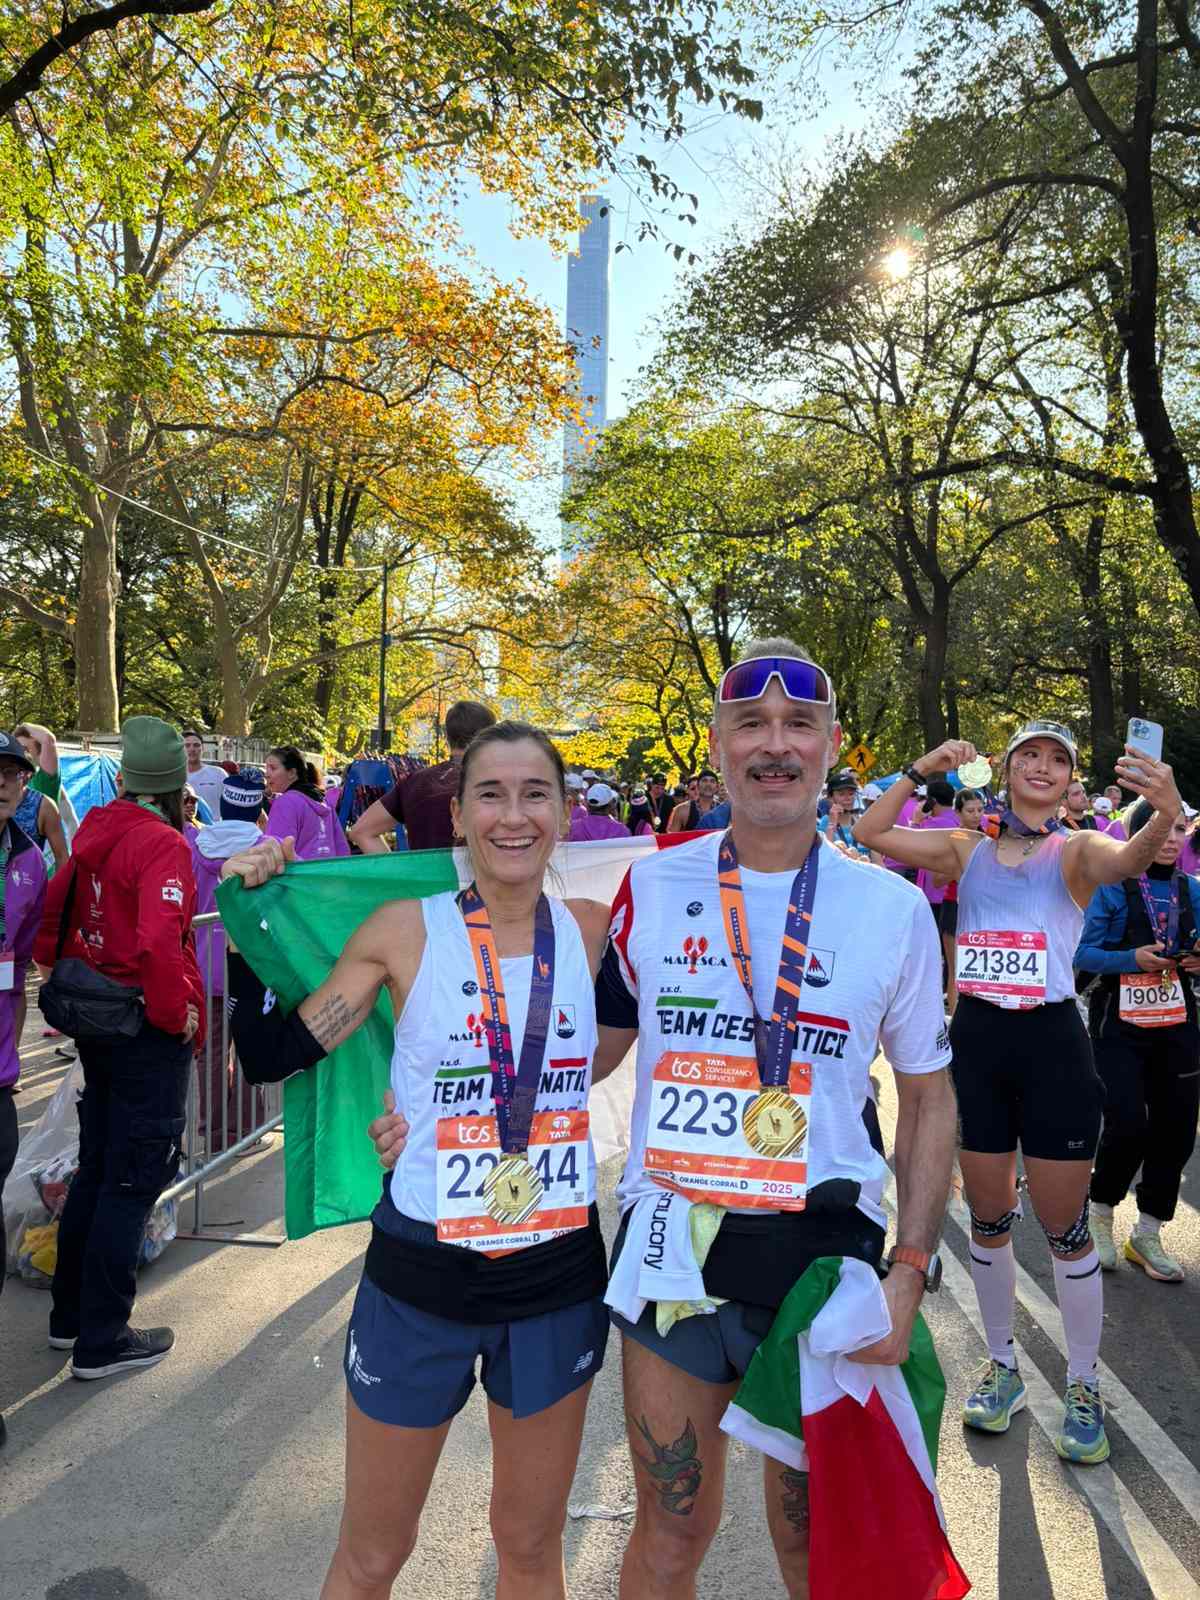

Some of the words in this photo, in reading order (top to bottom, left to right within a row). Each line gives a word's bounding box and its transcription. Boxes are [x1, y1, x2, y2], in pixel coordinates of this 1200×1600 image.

[964, 948, 1039, 976] 21384
[1126, 983, 1180, 1005] 19082
[657, 1010, 708, 1036] TEAM
[672, 1057, 701, 1080] tcs
[707, 1059, 726, 1067] TATA
[433, 1078, 485, 1104] TEAM
[657, 1086, 757, 1137] 223
[458, 1122, 491, 1144] tcs
[447, 1146, 579, 1199] 2244
[680, 1176, 708, 1186] ORANGE
[710, 1180, 738, 1188] CORRAL
[740, 1180, 748, 1190] D
[762, 1182, 793, 1194] 2025
[476, 1239, 503, 1247] ORANGE
[533, 1233, 540, 1243] D
[644, 1192, 674, 1270] saucony
